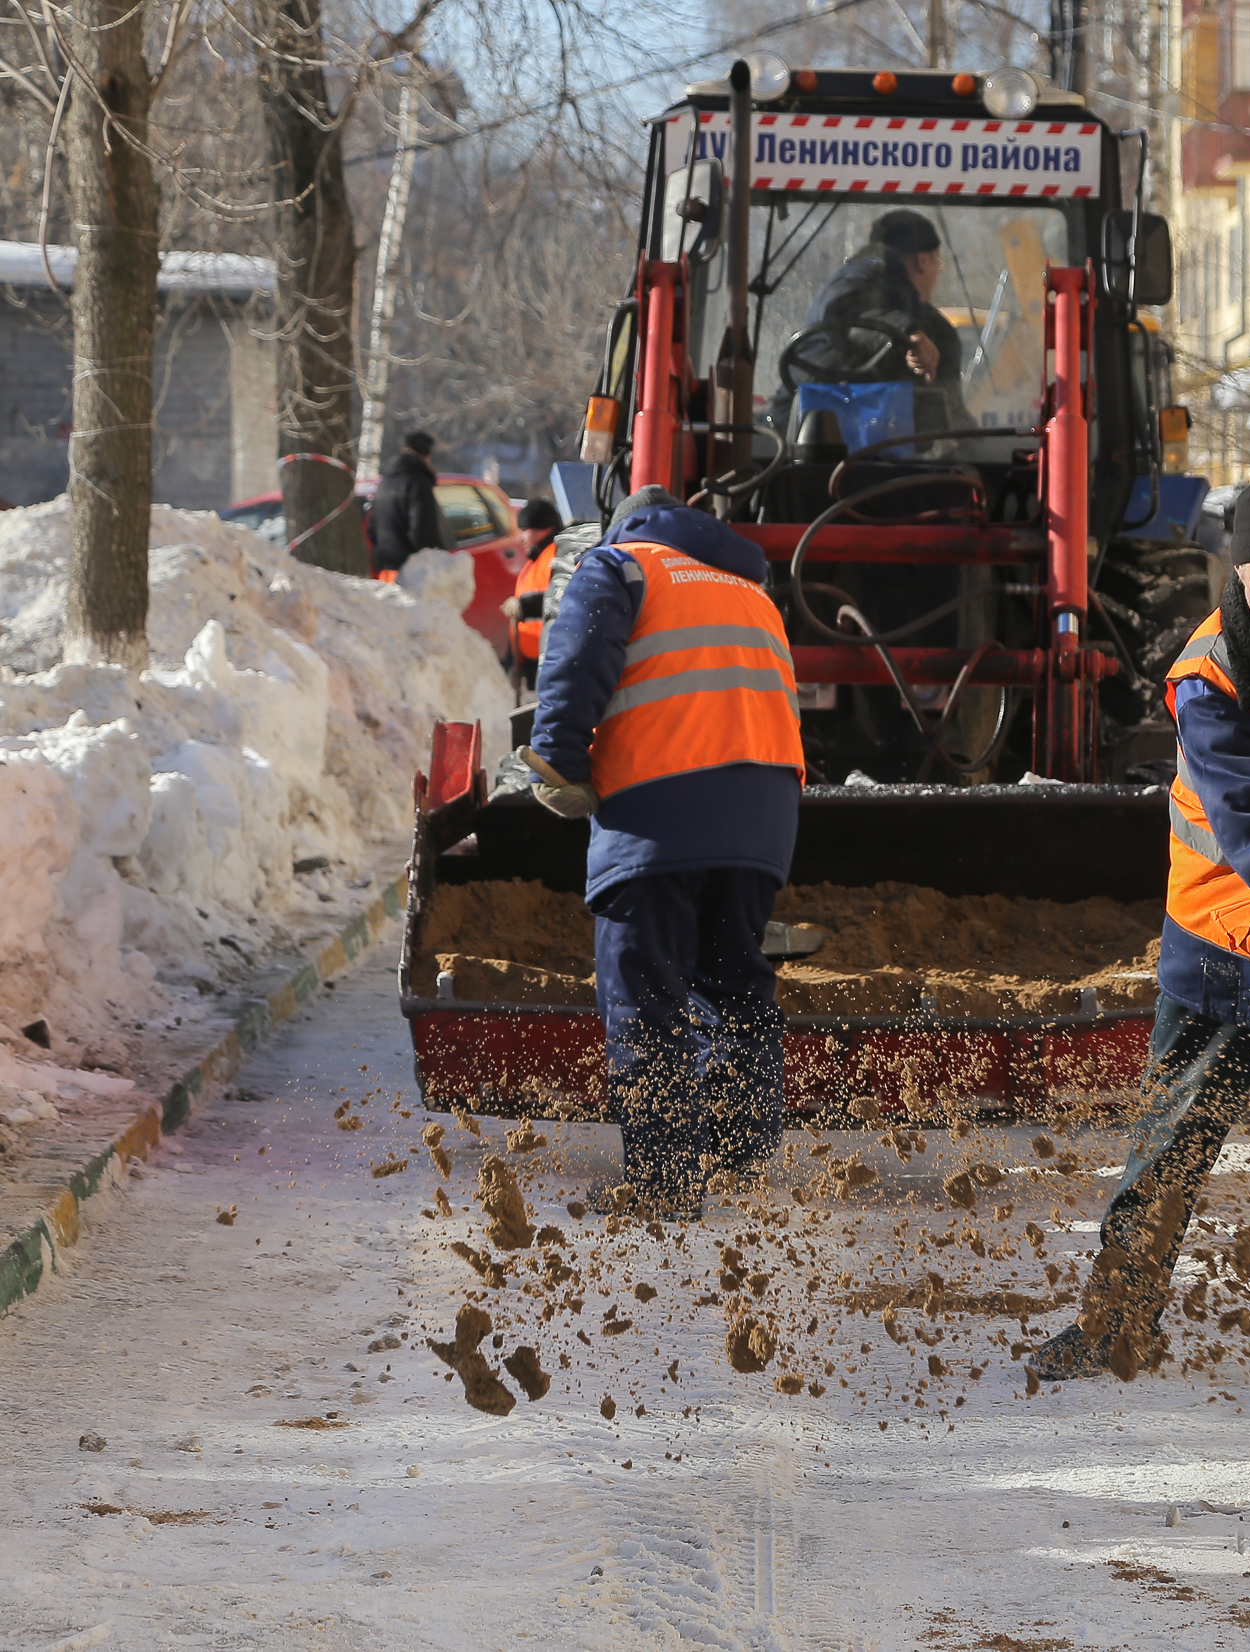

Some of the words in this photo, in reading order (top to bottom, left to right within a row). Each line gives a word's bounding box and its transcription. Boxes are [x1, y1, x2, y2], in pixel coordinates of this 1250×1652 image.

[754, 131, 951, 168] Ленинского
[960, 136, 1081, 172] района
[669, 569, 748, 588] ЛЕНИНСКОГО
